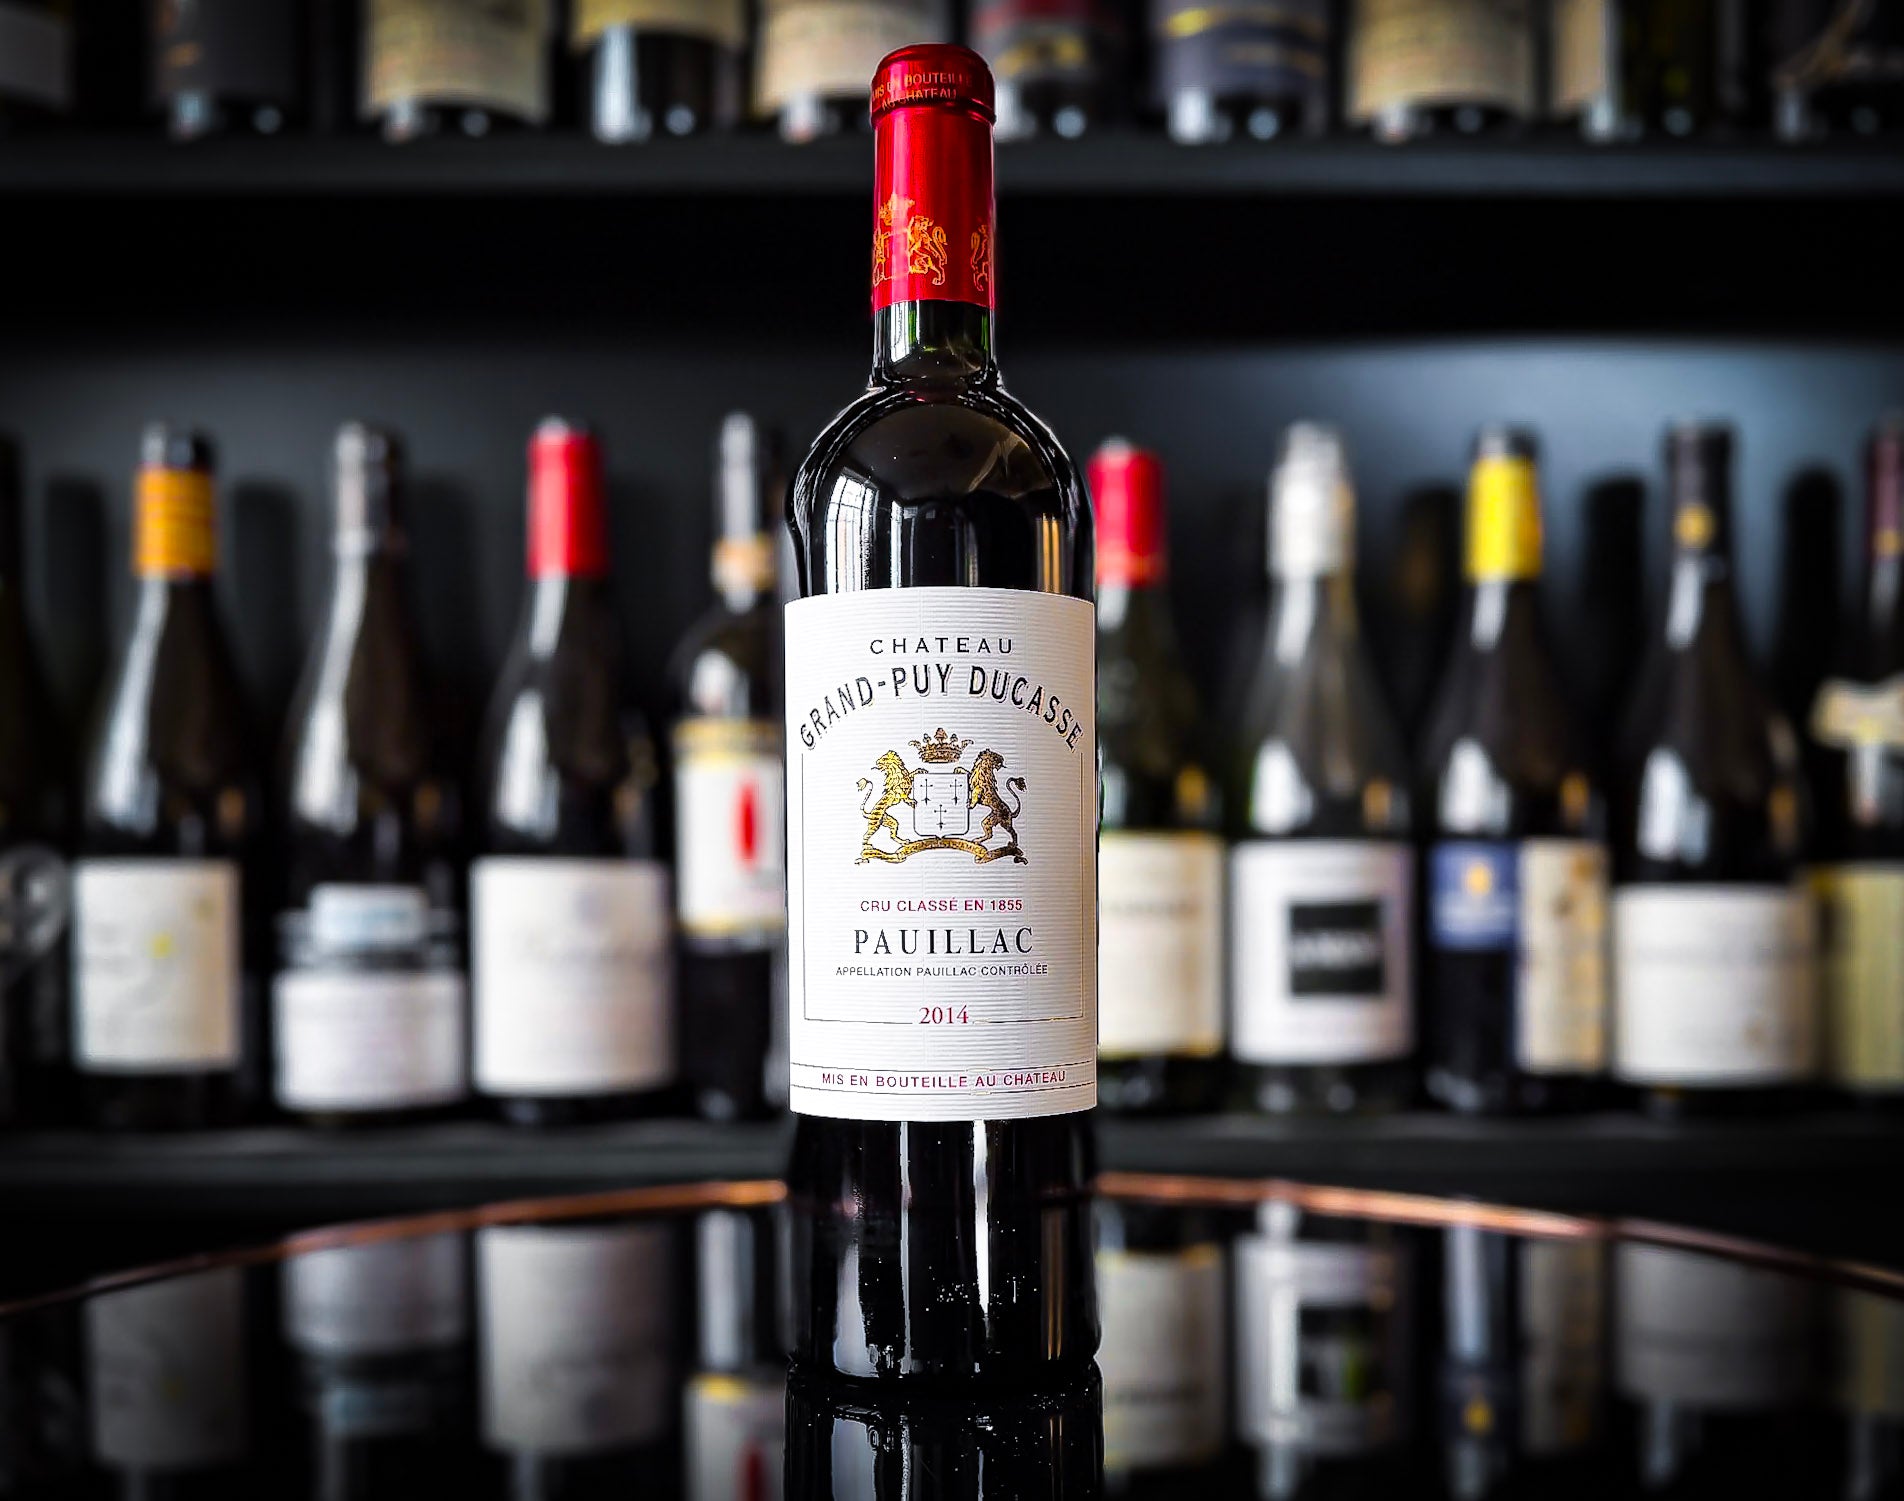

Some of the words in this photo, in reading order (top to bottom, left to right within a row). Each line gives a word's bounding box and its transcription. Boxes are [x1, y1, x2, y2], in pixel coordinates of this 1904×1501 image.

[869, 637, 1013, 655] CHATEAU
[800, 663, 953, 750] GRAND-PUY
[969, 665, 1084, 753] DUCASSE
[860, 899, 891, 912] CRU
[896, 896, 959, 912] CLASSÉ
[964, 899, 985, 911] EN
[989, 899, 1023, 912] 1855
[853, 927, 1034, 955] PAUILLAC
[835, 966, 912, 977] APPELLATION
[916, 966, 977, 977] PAUILLAC
[981, 962, 1049, 976] CONTRÔLÉE
[918, 1004, 970, 1025] 2014
[821, 1072, 845, 1085] MIS
[850, 1074, 868, 1087] EN
[875, 1075, 968, 1089] BOUTEILLE
[975, 1075, 997, 1088] AU
[1003, 1069, 1067, 1086] CHATEAU
